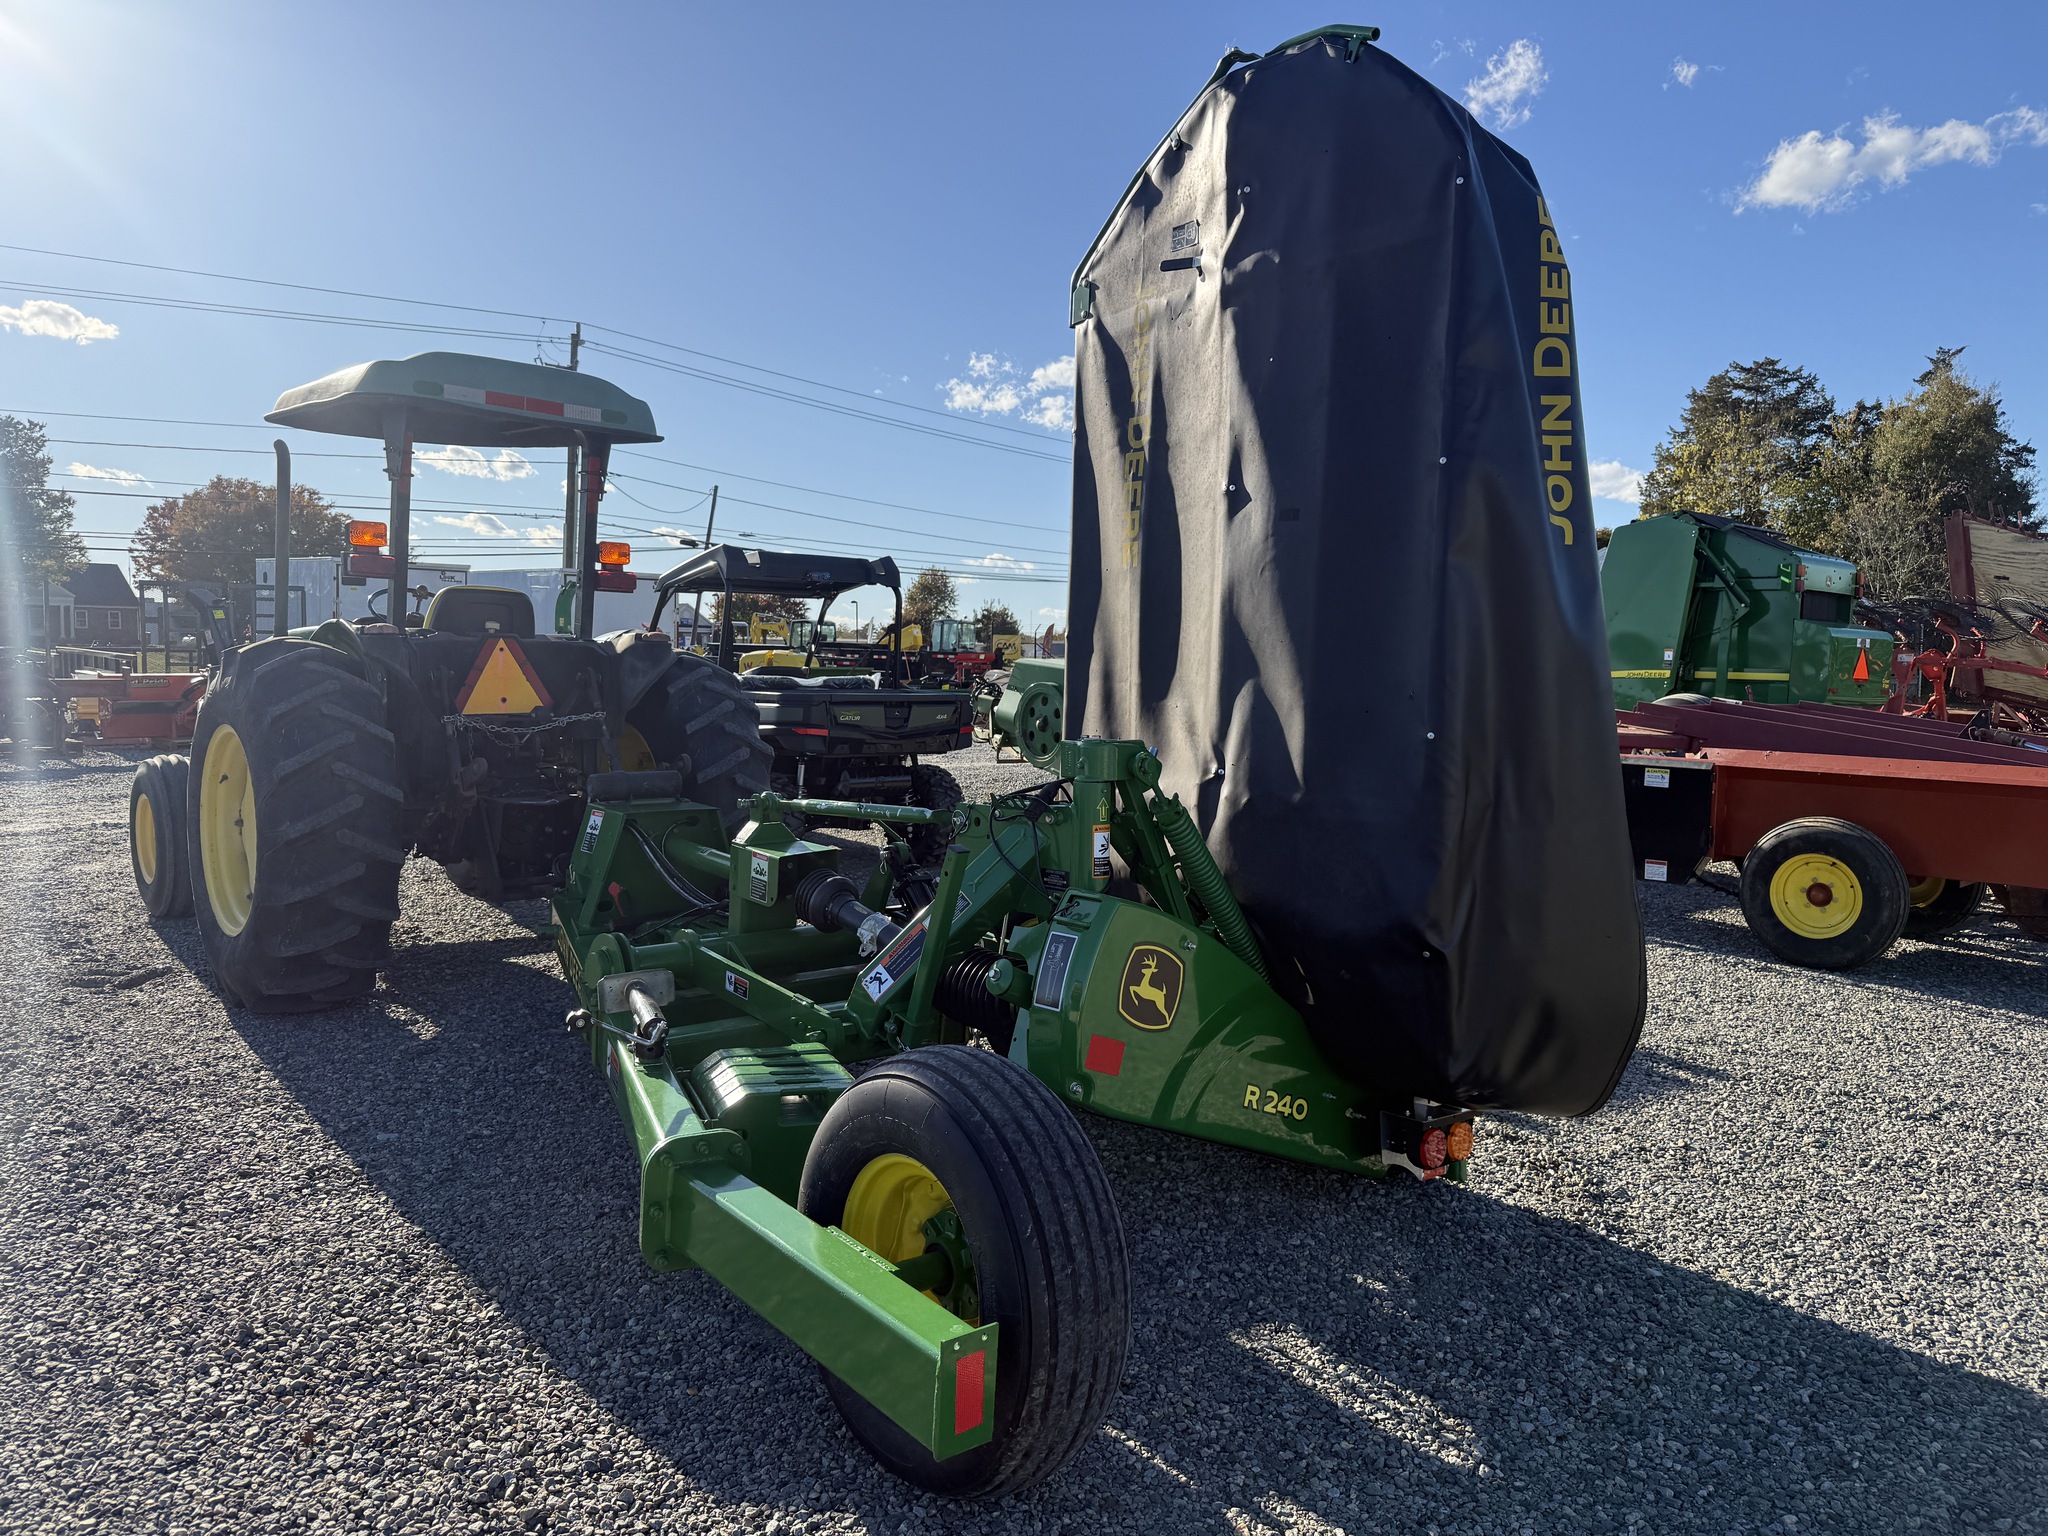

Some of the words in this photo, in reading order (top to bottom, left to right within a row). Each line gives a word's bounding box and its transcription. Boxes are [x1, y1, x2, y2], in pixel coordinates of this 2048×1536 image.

[1131, 281, 1154, 403] JOHN
[1121, 414, 1152, 569] DEERE
[1540, 395, 1573, 546] JOHN
[996, 642, 1016, 651] CAM
[890, 933, 914, 957] WARNING
[1243, 1084, 1261, 1110] R
[1263, 1090, 1308, 1121] 240
